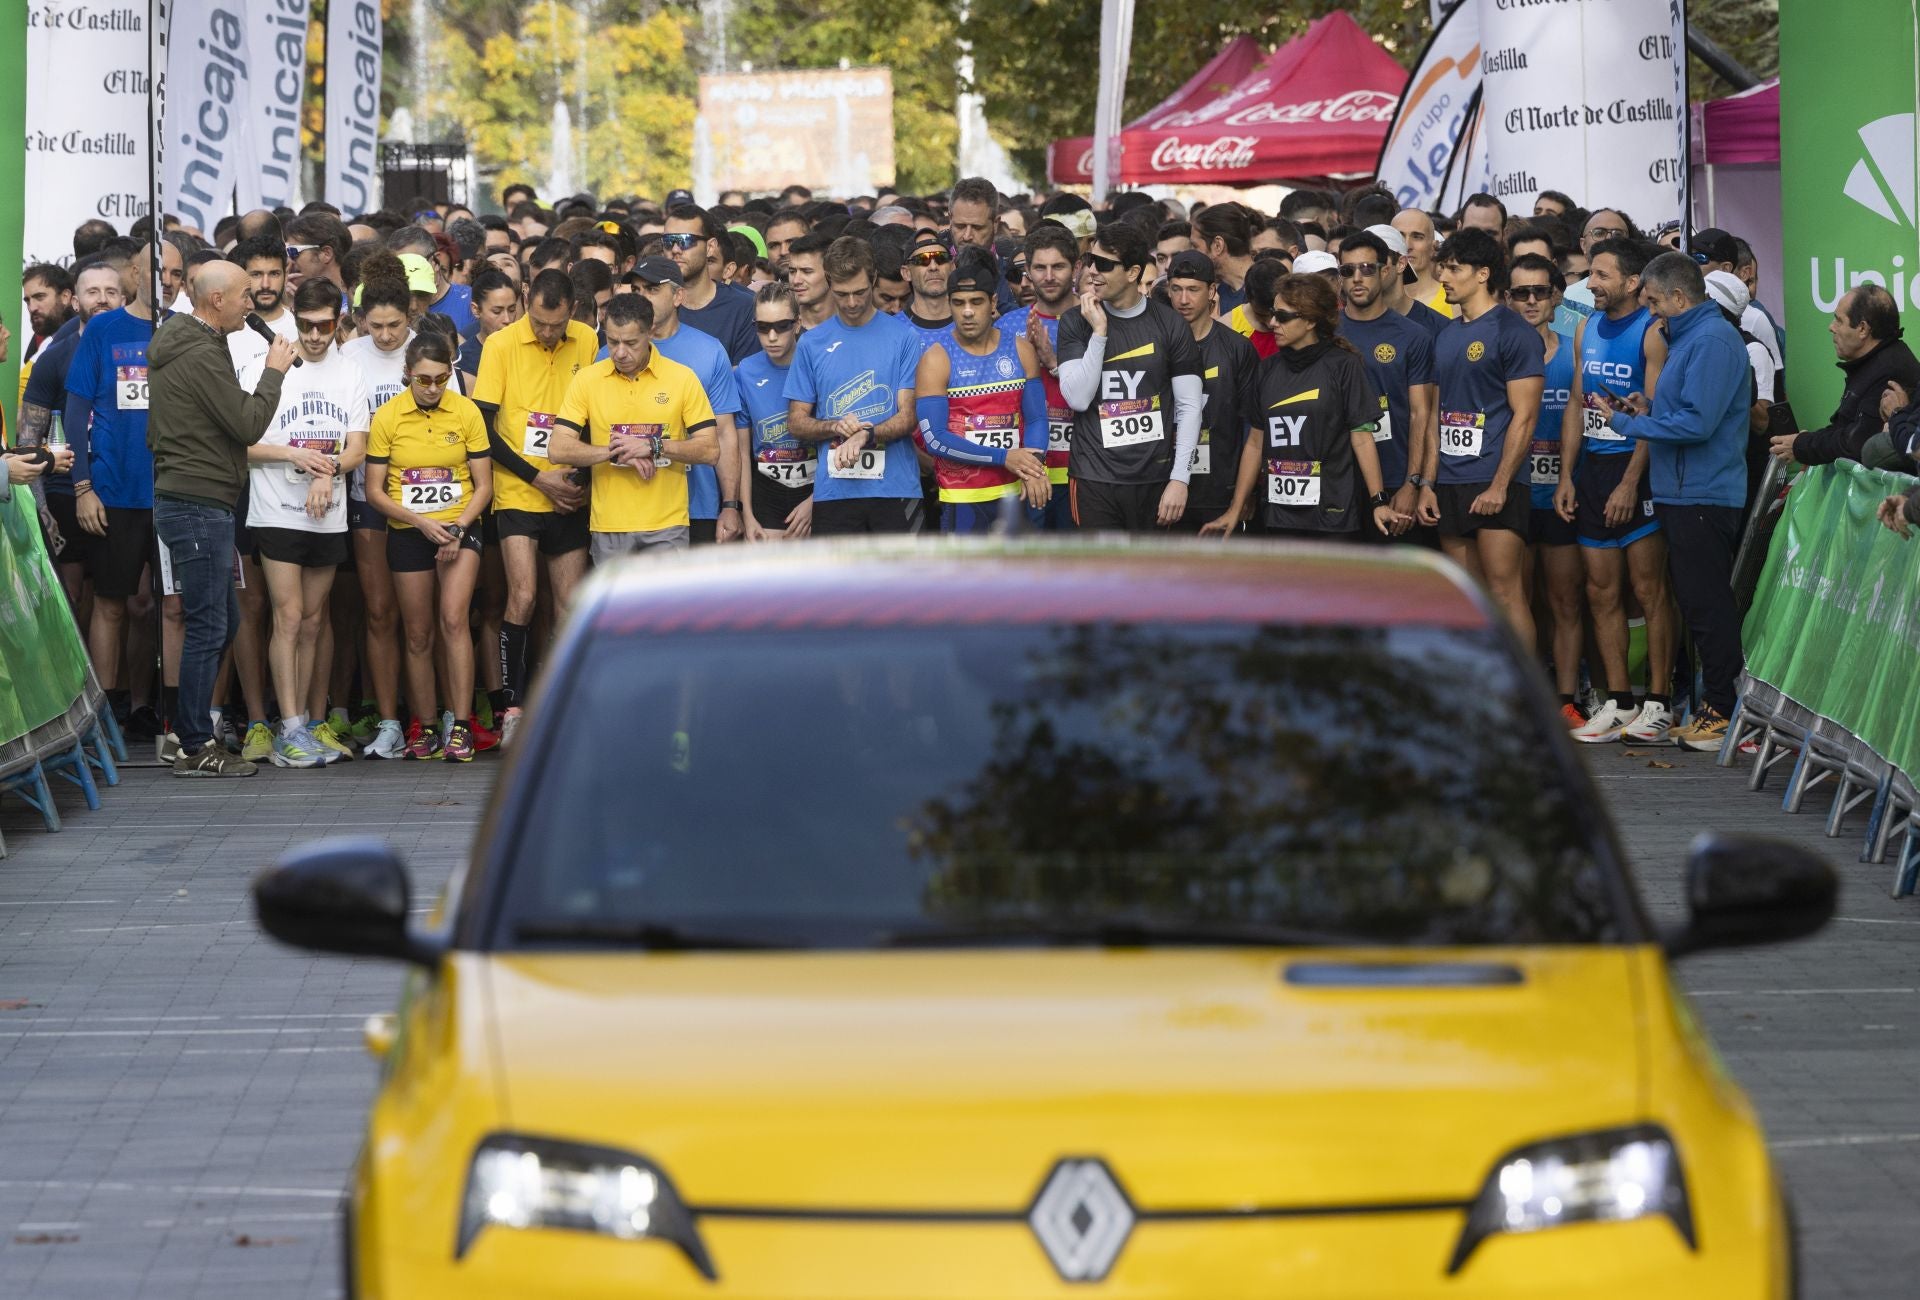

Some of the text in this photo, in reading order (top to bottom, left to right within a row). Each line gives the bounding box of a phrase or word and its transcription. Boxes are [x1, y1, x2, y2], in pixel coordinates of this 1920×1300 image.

[44, 6, 64, 28] de
[68, 6, 141, 31] Castilla
[1639, 35, 1661, 60] El
[104, 70, 126, 94] El
[1411, 94, 1451, 151] grupo
[1505, 98, 1674, 133] El Norte de Castilla
[37, 130, 57, 152] de
[62, 130, 136, 155] Castilla
[97, 194, 120, 217] El
[1101, 370, 1146, 400] EY
[1606, 378, 1631, 388] running
[302, 391, 325, 400] HOSPITAL
[280, 399, 350, 430] RIO HORTEGA
[1110, 415, 1153, 437] 309
[290, 430, 341, 439] UNIVERSITARIO
[975, 431, 1013, 449] 755
[1268, 415, 1307, 448] EY
[1445, 427, 1473, 447] 168
[767, 463, 807, 480] 371
[411, 485, 453, 504] 226
[1274, 476, 1310, 496] 307
